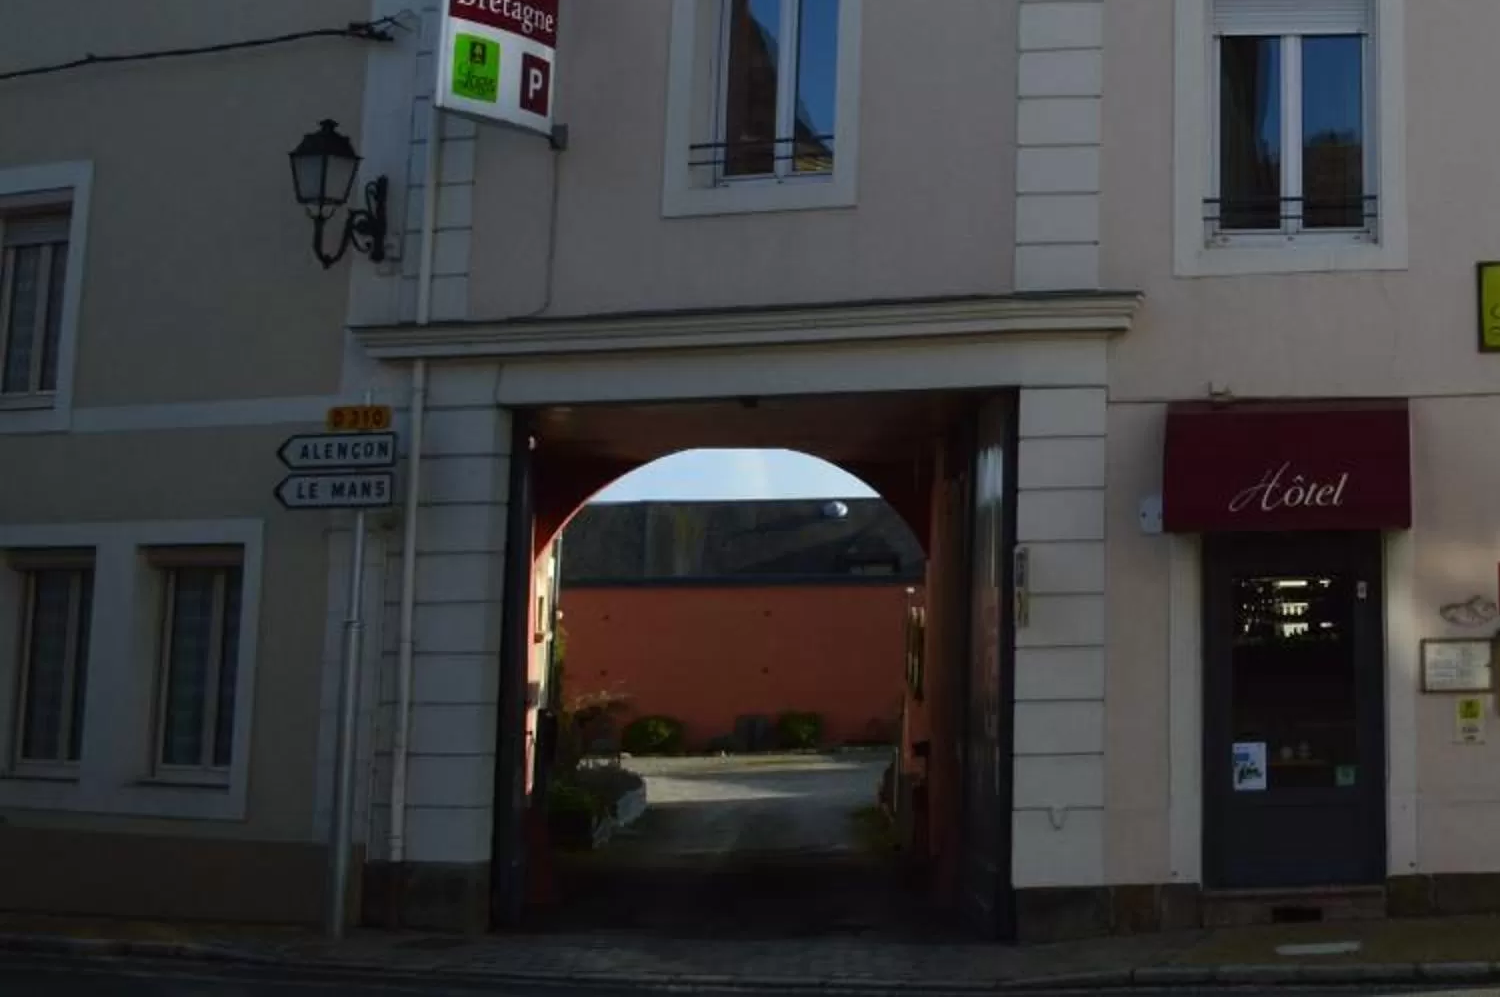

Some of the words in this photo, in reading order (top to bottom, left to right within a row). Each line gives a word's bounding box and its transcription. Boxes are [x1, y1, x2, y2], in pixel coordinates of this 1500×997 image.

[529, 68, 543, 99] P
[300, 442, 388, 460] ALENÇON
[296, 482, 319, 500] LE
[331, 481, 385, 500] MANS
[1228, 461, 1348, 511] Hôtel
